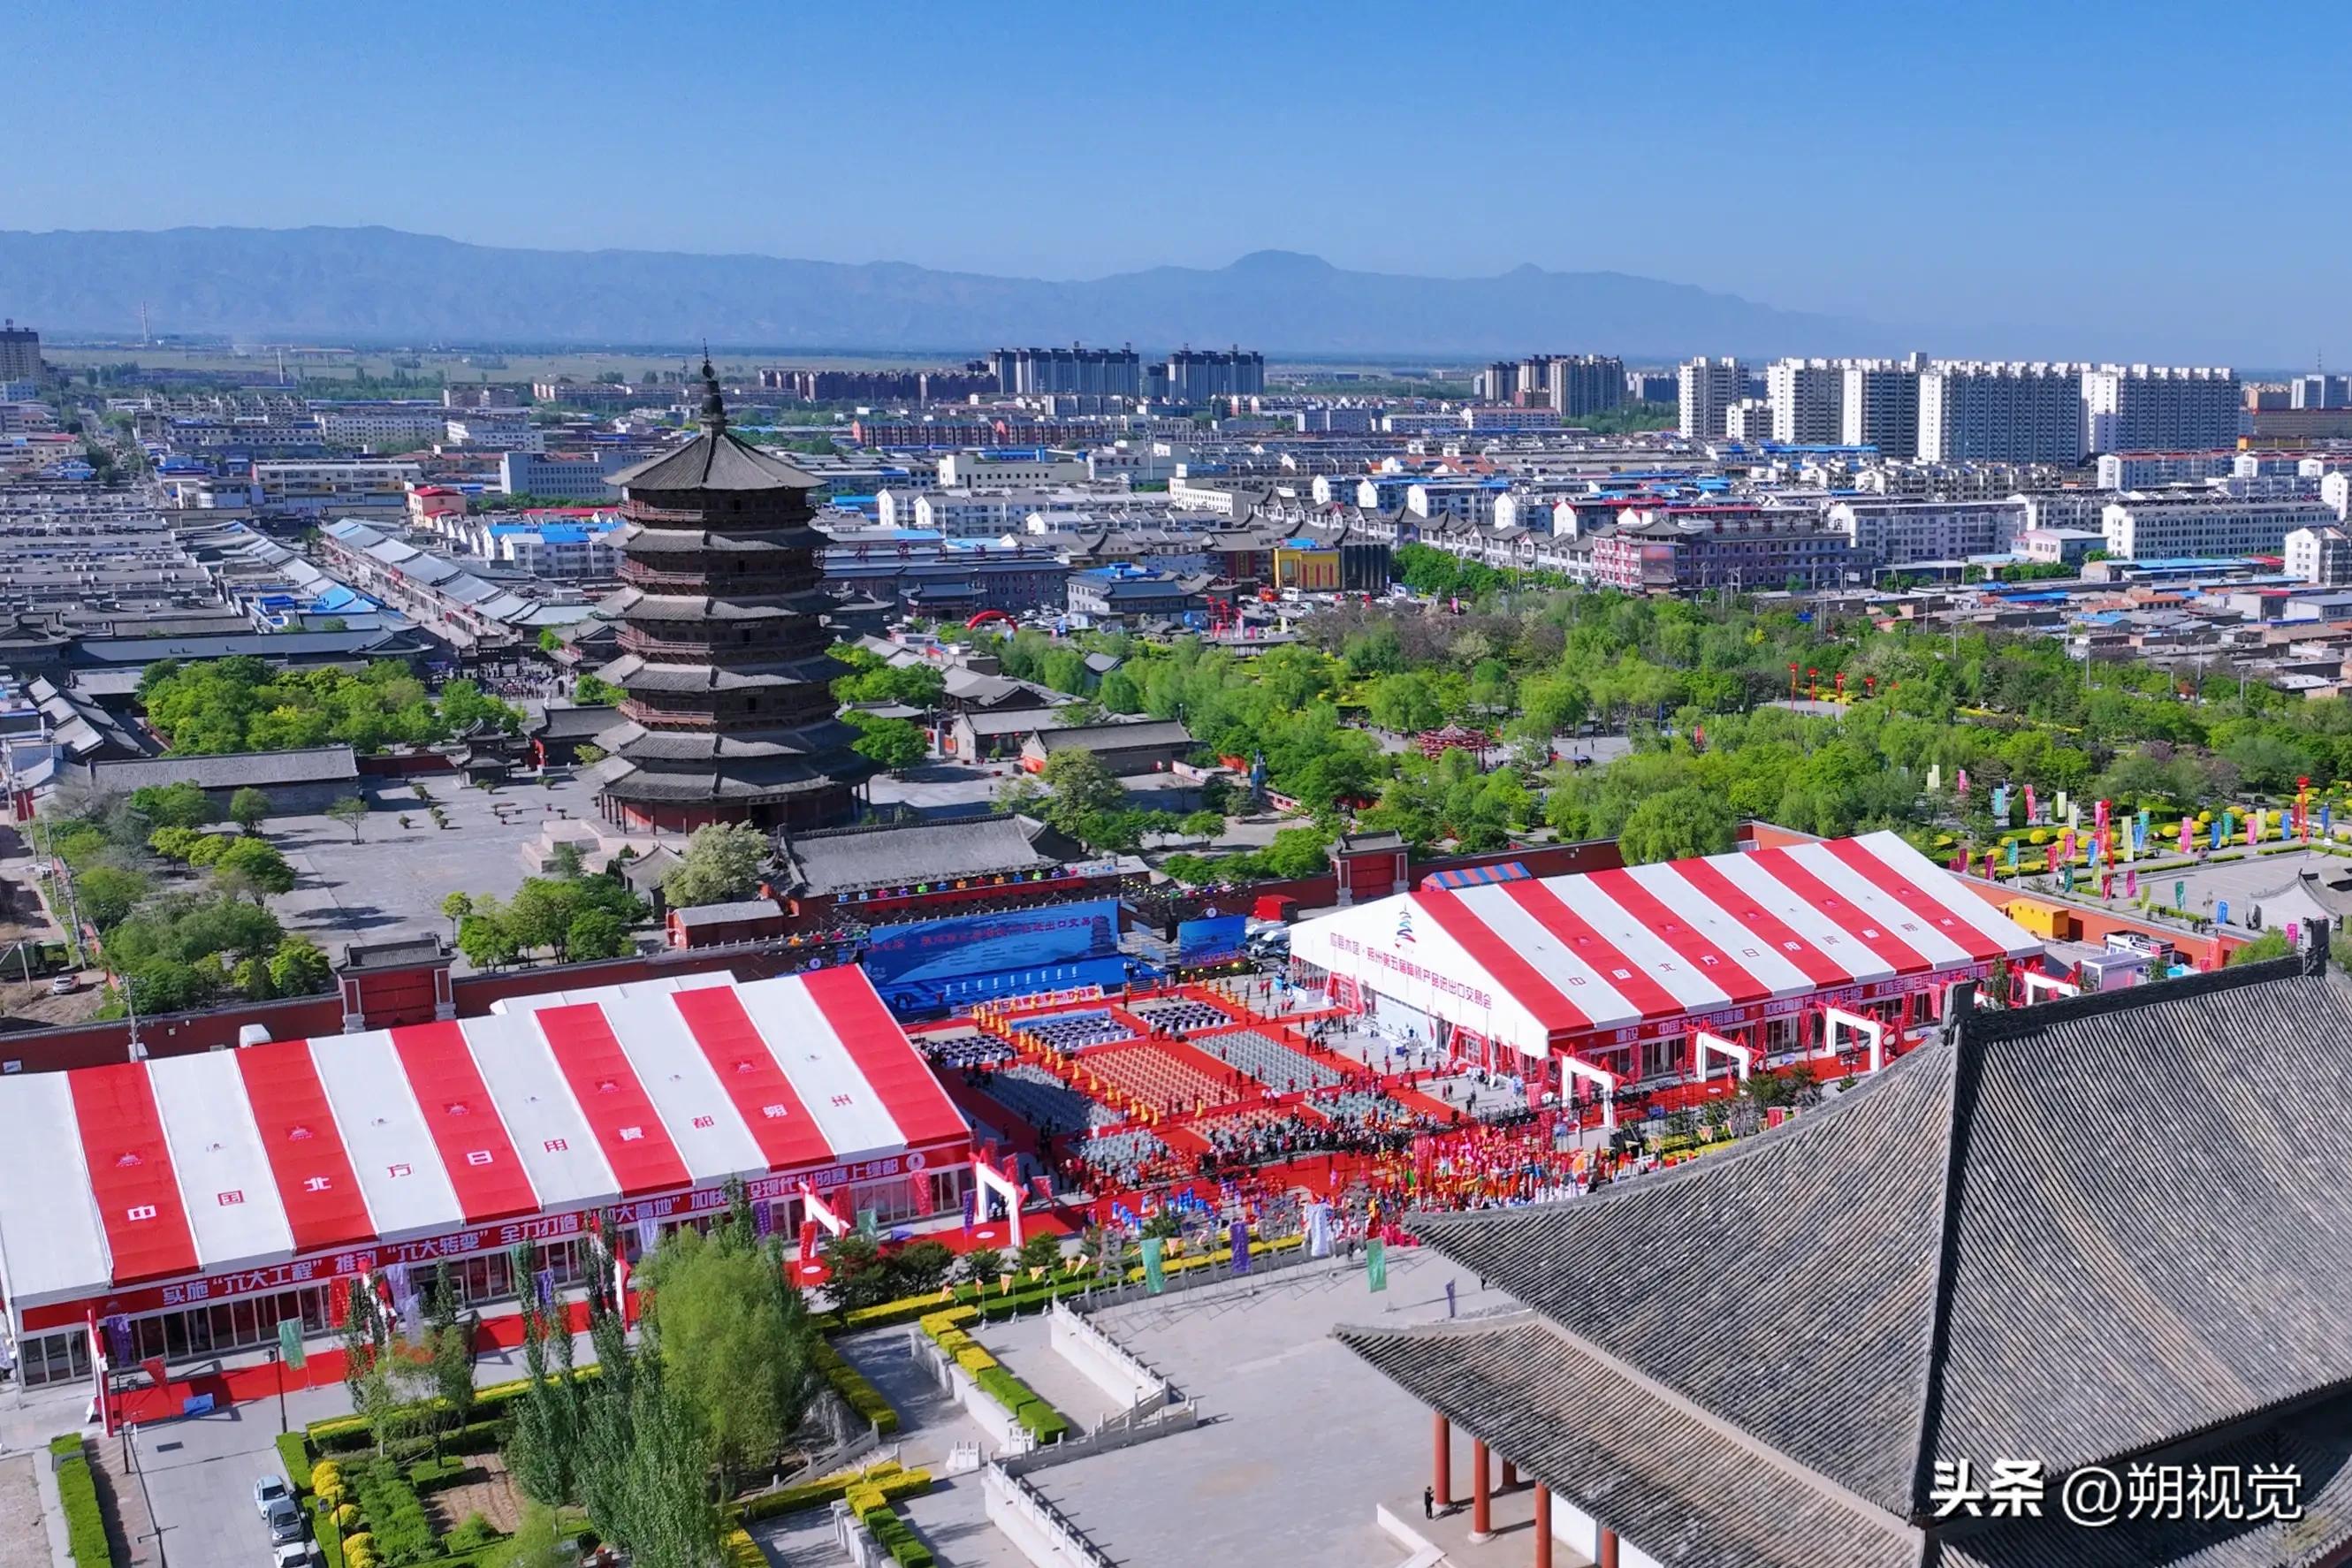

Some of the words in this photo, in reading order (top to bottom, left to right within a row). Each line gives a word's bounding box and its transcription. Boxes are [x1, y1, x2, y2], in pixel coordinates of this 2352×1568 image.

[690, 1158, 898, 1210] 加快设现代化的塞上绿都
